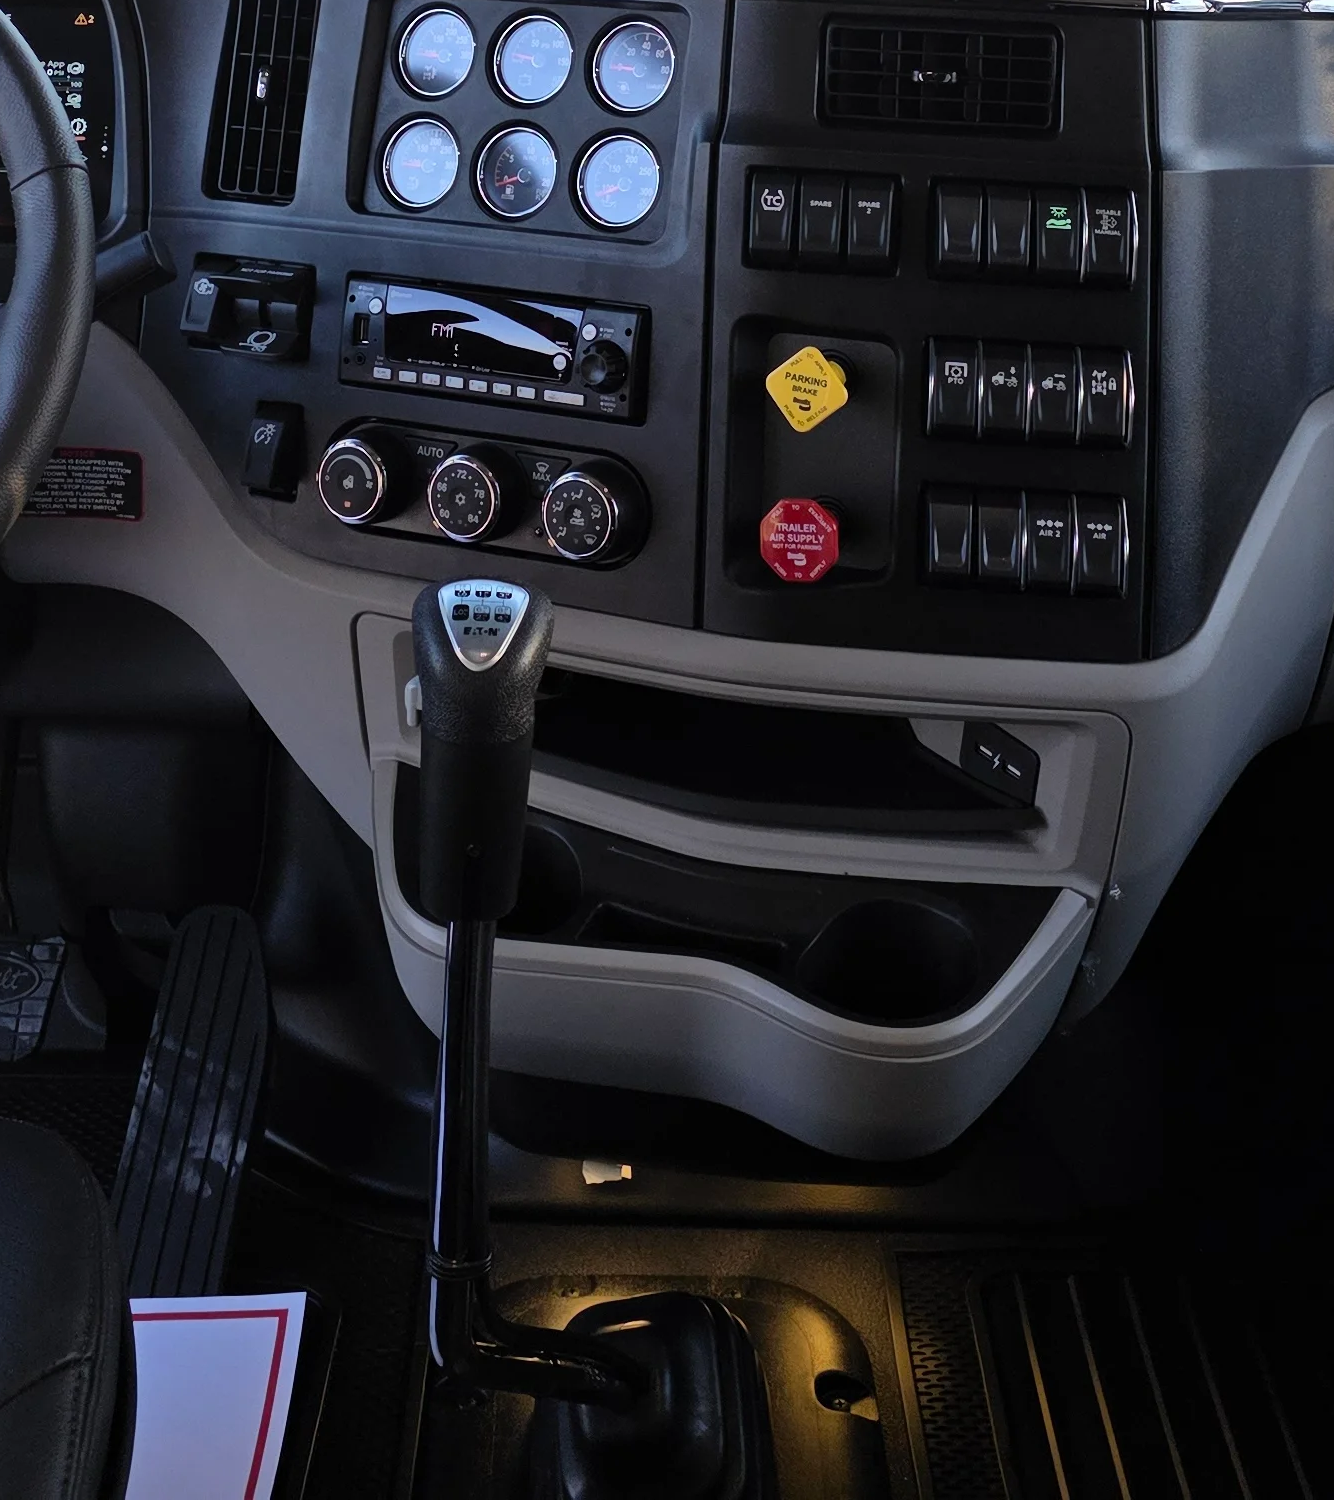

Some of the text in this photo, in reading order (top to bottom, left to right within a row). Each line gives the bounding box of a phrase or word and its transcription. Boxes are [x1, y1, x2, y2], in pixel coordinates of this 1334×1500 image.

[87, 14, 96, 24] 2
[642, 41, 652, 50] 40
[627, 48, 636, 57] 20
[656, 50, 665, 58] 60
[47, 60, 65, 70] App
[661, 66, 671, 75] 80
[508, 155, 515, 163] 5
[625, 155, 639, 164] 200
[609, 164, 622, 173] 150
[639, 167, 653, 176] 250
[765, 195, 782, 206] TC
[809, 200, 833, 208] SPARE
[857, 201, 881, 209] SPARE
[1095, 208, 1122, 217] DISABLE
[1094, 229, 1122, 237] MANUAL
[806, 352, 815, 360] TO
[784, 371, 828, 388] PARKING
[947, 377, 965, 385] PTO
[791, 384, 819, 397] BRAKE
[796, 419, 805, 427] TO
[805, 405, 828, 423] RELEASE
[416, 445, 445, 459] AUTO
[107, 460, 124, 468] WITH
[92, 466, 132, 475] PROTECTION
[457, 470, 468, 481] 72
[532, 472, 552, 483] MAX
[106, 479, 126, 487] AFTER
[436, 482, 448, 493] 66
[474, 488, 486, 500] 78
[78, 498, 116, 506] RESTARTED
[439, 509, 451, 520] 60
[467, 513, 479, 525] 84
[807, 506, 833, 533] EVACUATE
[776, 522, 817, 534] TRAILER
[1038, 529, 1061, 538] AIR 2
[1092, 532, 1107, 540] AIR
[769, 533, 825, 544] AIR SUPPLY
